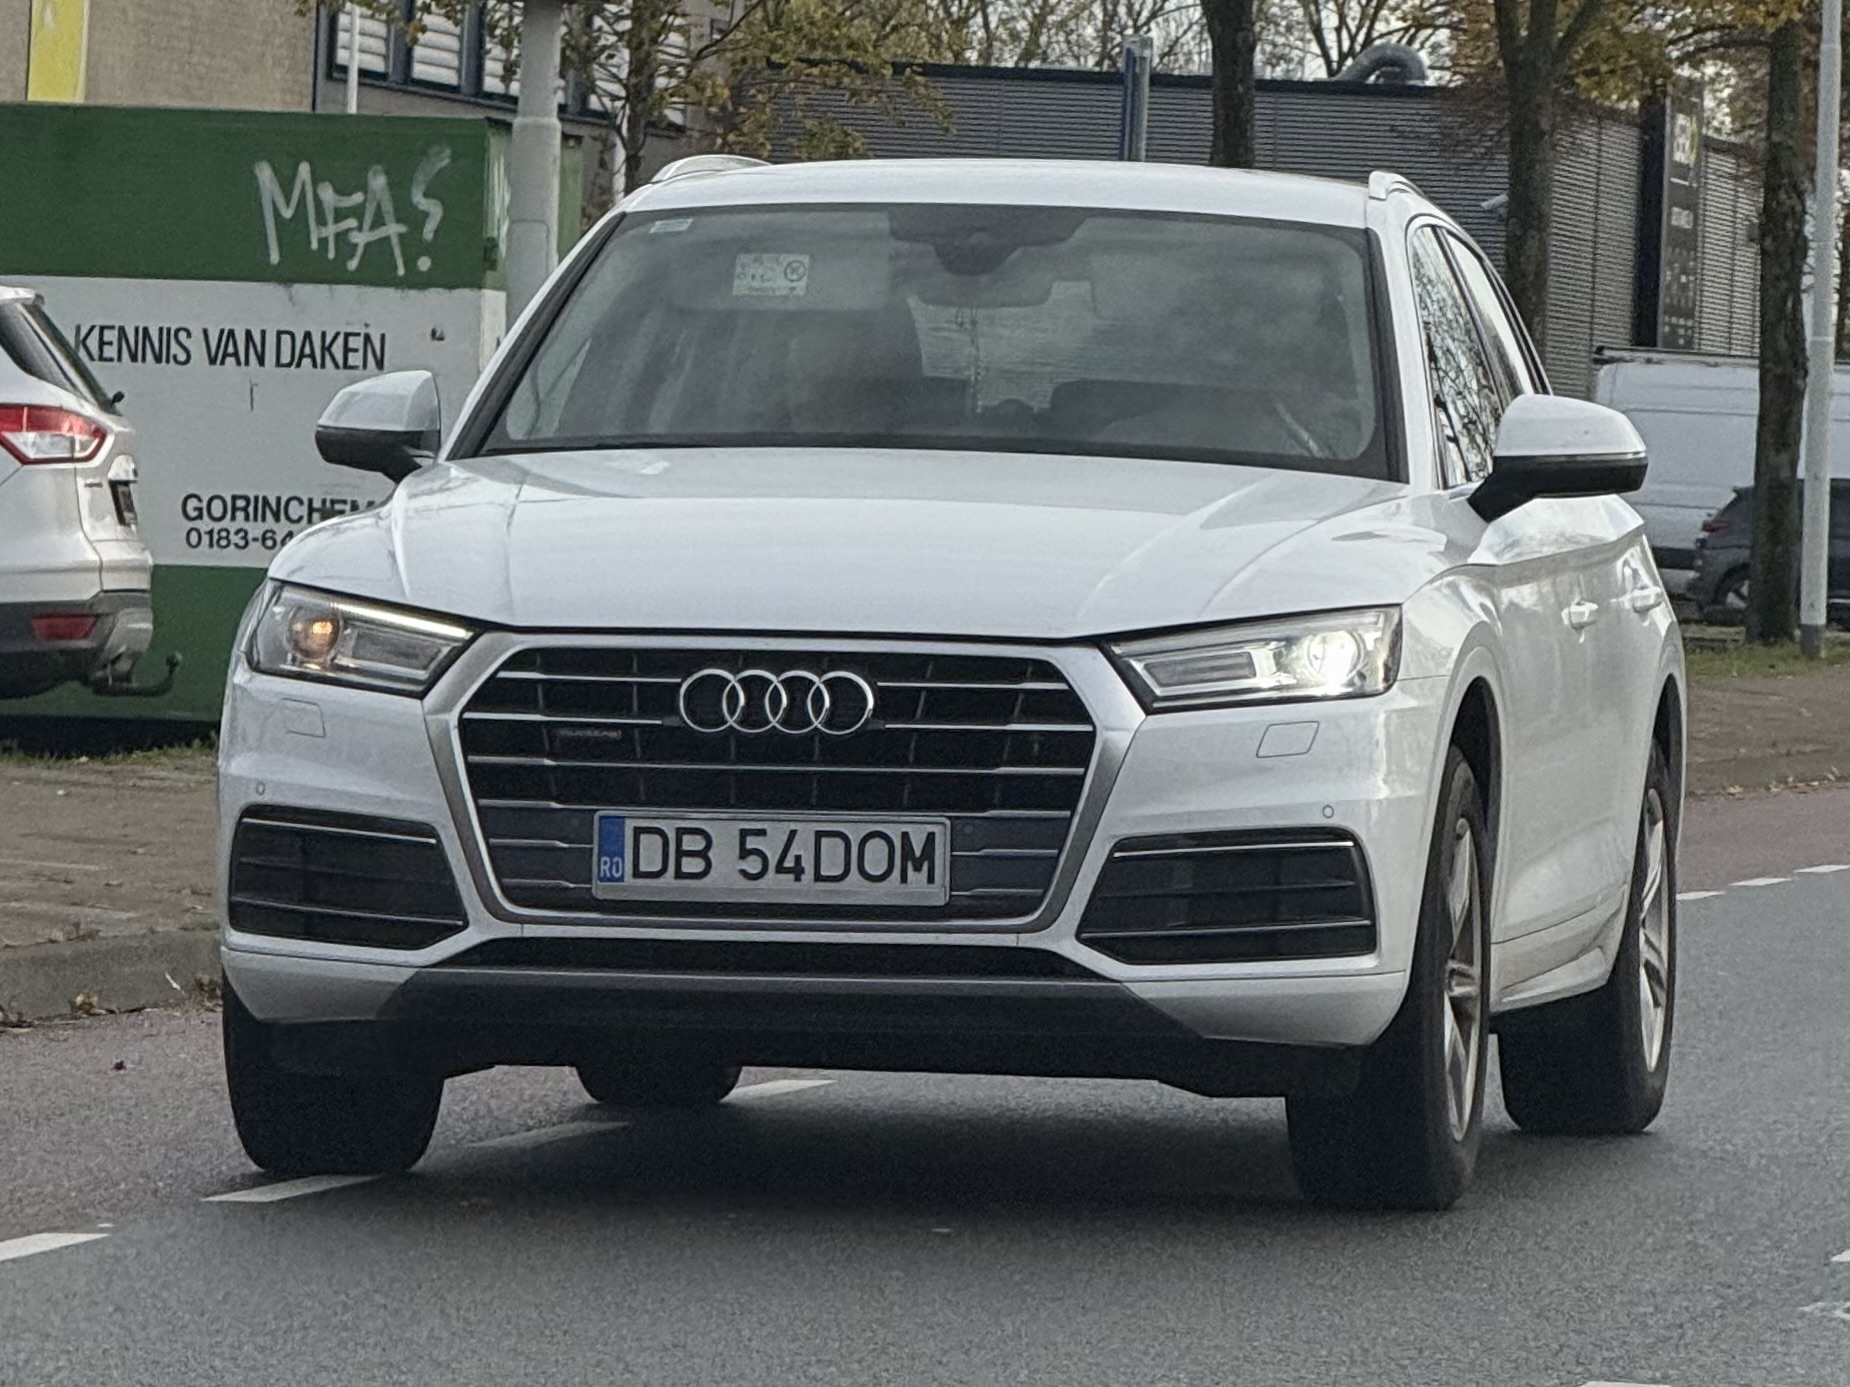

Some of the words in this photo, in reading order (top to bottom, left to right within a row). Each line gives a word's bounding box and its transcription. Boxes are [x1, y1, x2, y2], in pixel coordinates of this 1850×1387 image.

[74, 323, 192, 366] KENNIS
[202, 327, 267, 368] VAN
[274, 329, 386, 371] DAKEN
[632, 826, 713, 880] DB
[737, 828, 936, 885] 54DOM
